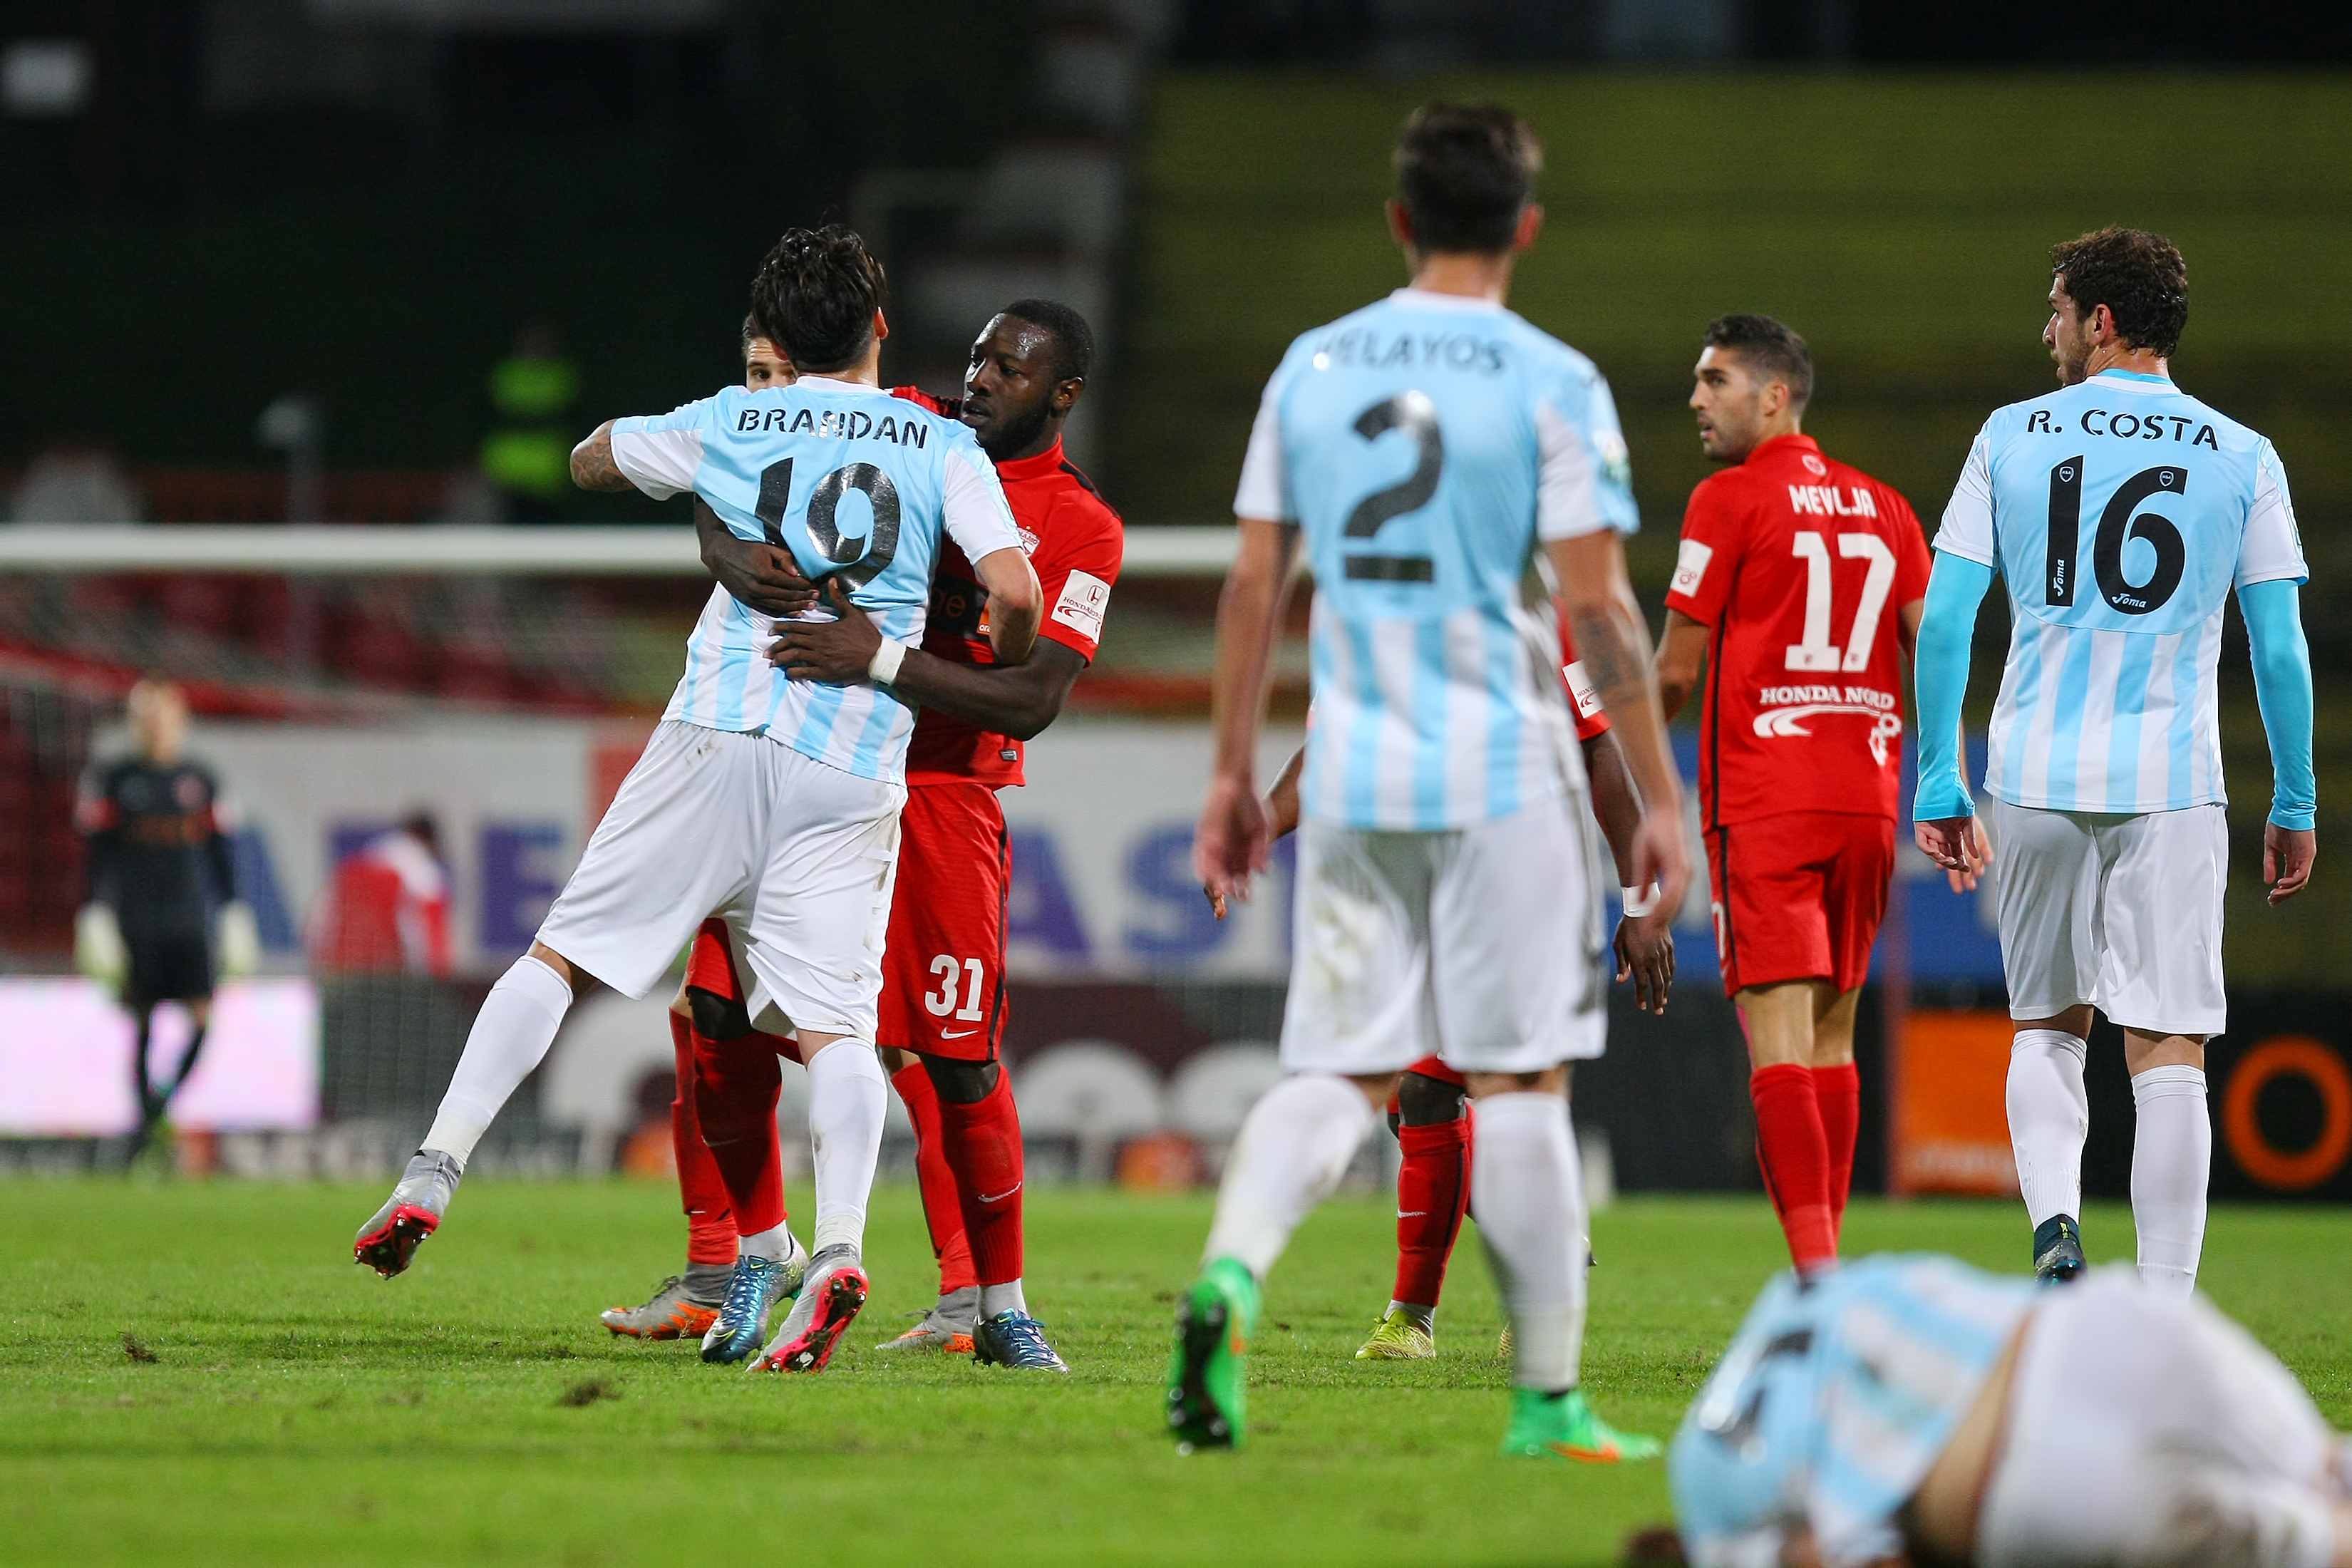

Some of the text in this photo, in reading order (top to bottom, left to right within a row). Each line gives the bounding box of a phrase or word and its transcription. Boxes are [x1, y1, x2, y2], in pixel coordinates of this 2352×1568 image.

[737, 408, 928, 449] BRANDAN
[2027, 408, 2219, 451] R. COSTA
[1340, 391, 1444, 584] 2
[1788, 485, 1877, 519] MEVLJA
[2046, 455, 2188, 615] 16
[2053, 559, 2065, 597] Joma
[1784, 532, 1897, 673] 17
[2112, 593, 2147, 608] Joma
[1760, 686, 1841, 704] HONDA
[925, 954, 983, 1021] 31
